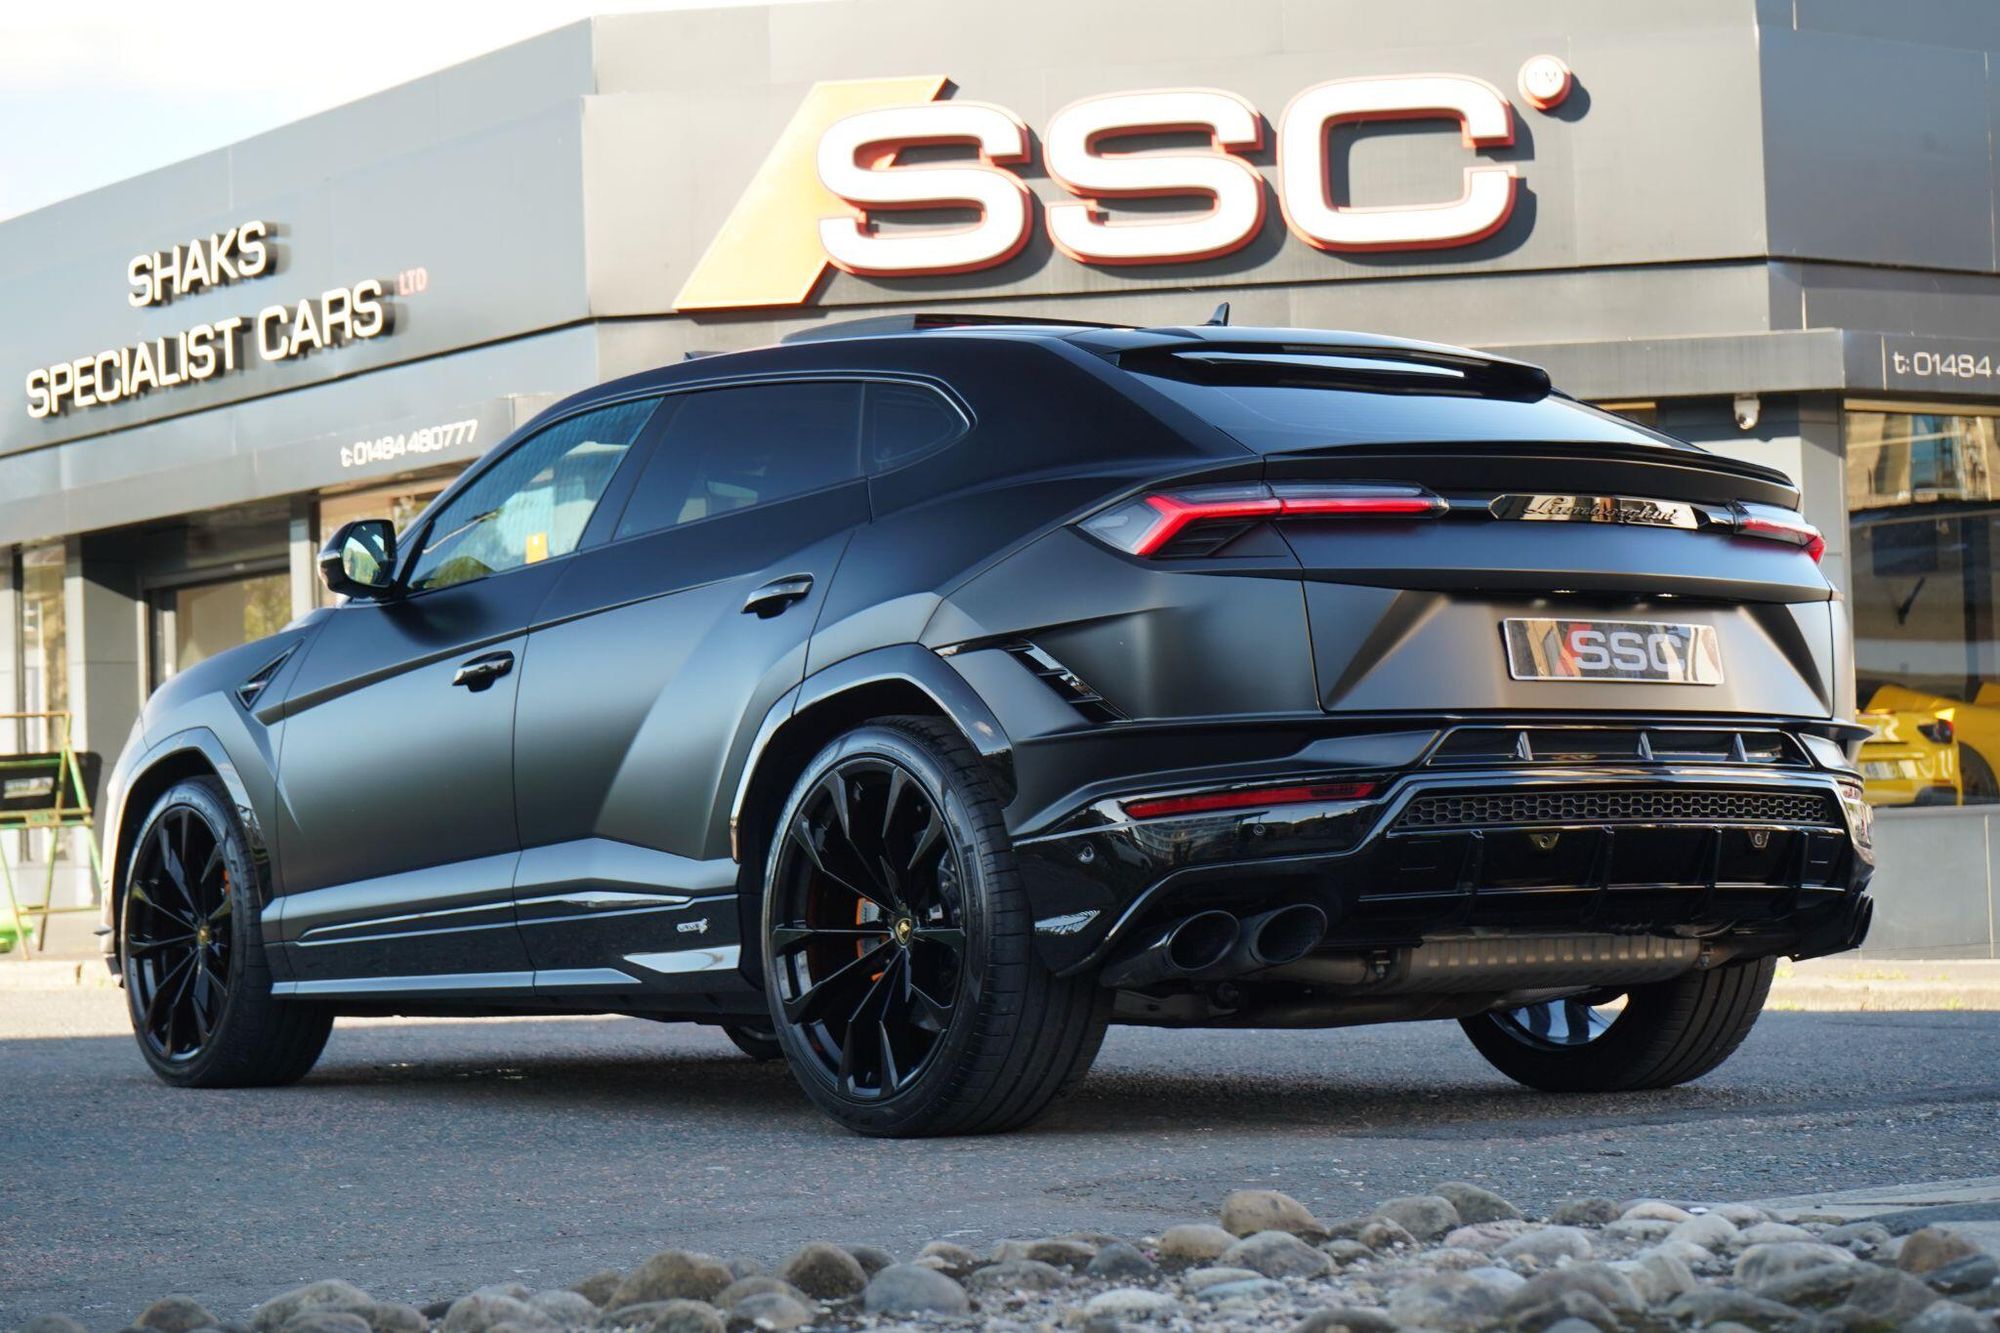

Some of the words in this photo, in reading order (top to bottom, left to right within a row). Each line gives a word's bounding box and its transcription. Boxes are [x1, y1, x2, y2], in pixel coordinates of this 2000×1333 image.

[817, 72, 1517, 276] SSC
[127, 219, 268, 308] SHAKS
[25, 316, 242, 419] SPECIALIST
[257, 279, 385, 362] CARS
[399, 267, 428, 297] LTD
[407, 418, 479, 453] 480777
[1524, 496, 1681, 524] Lamborghini
[1570, 630, 1686, 673] SSC
